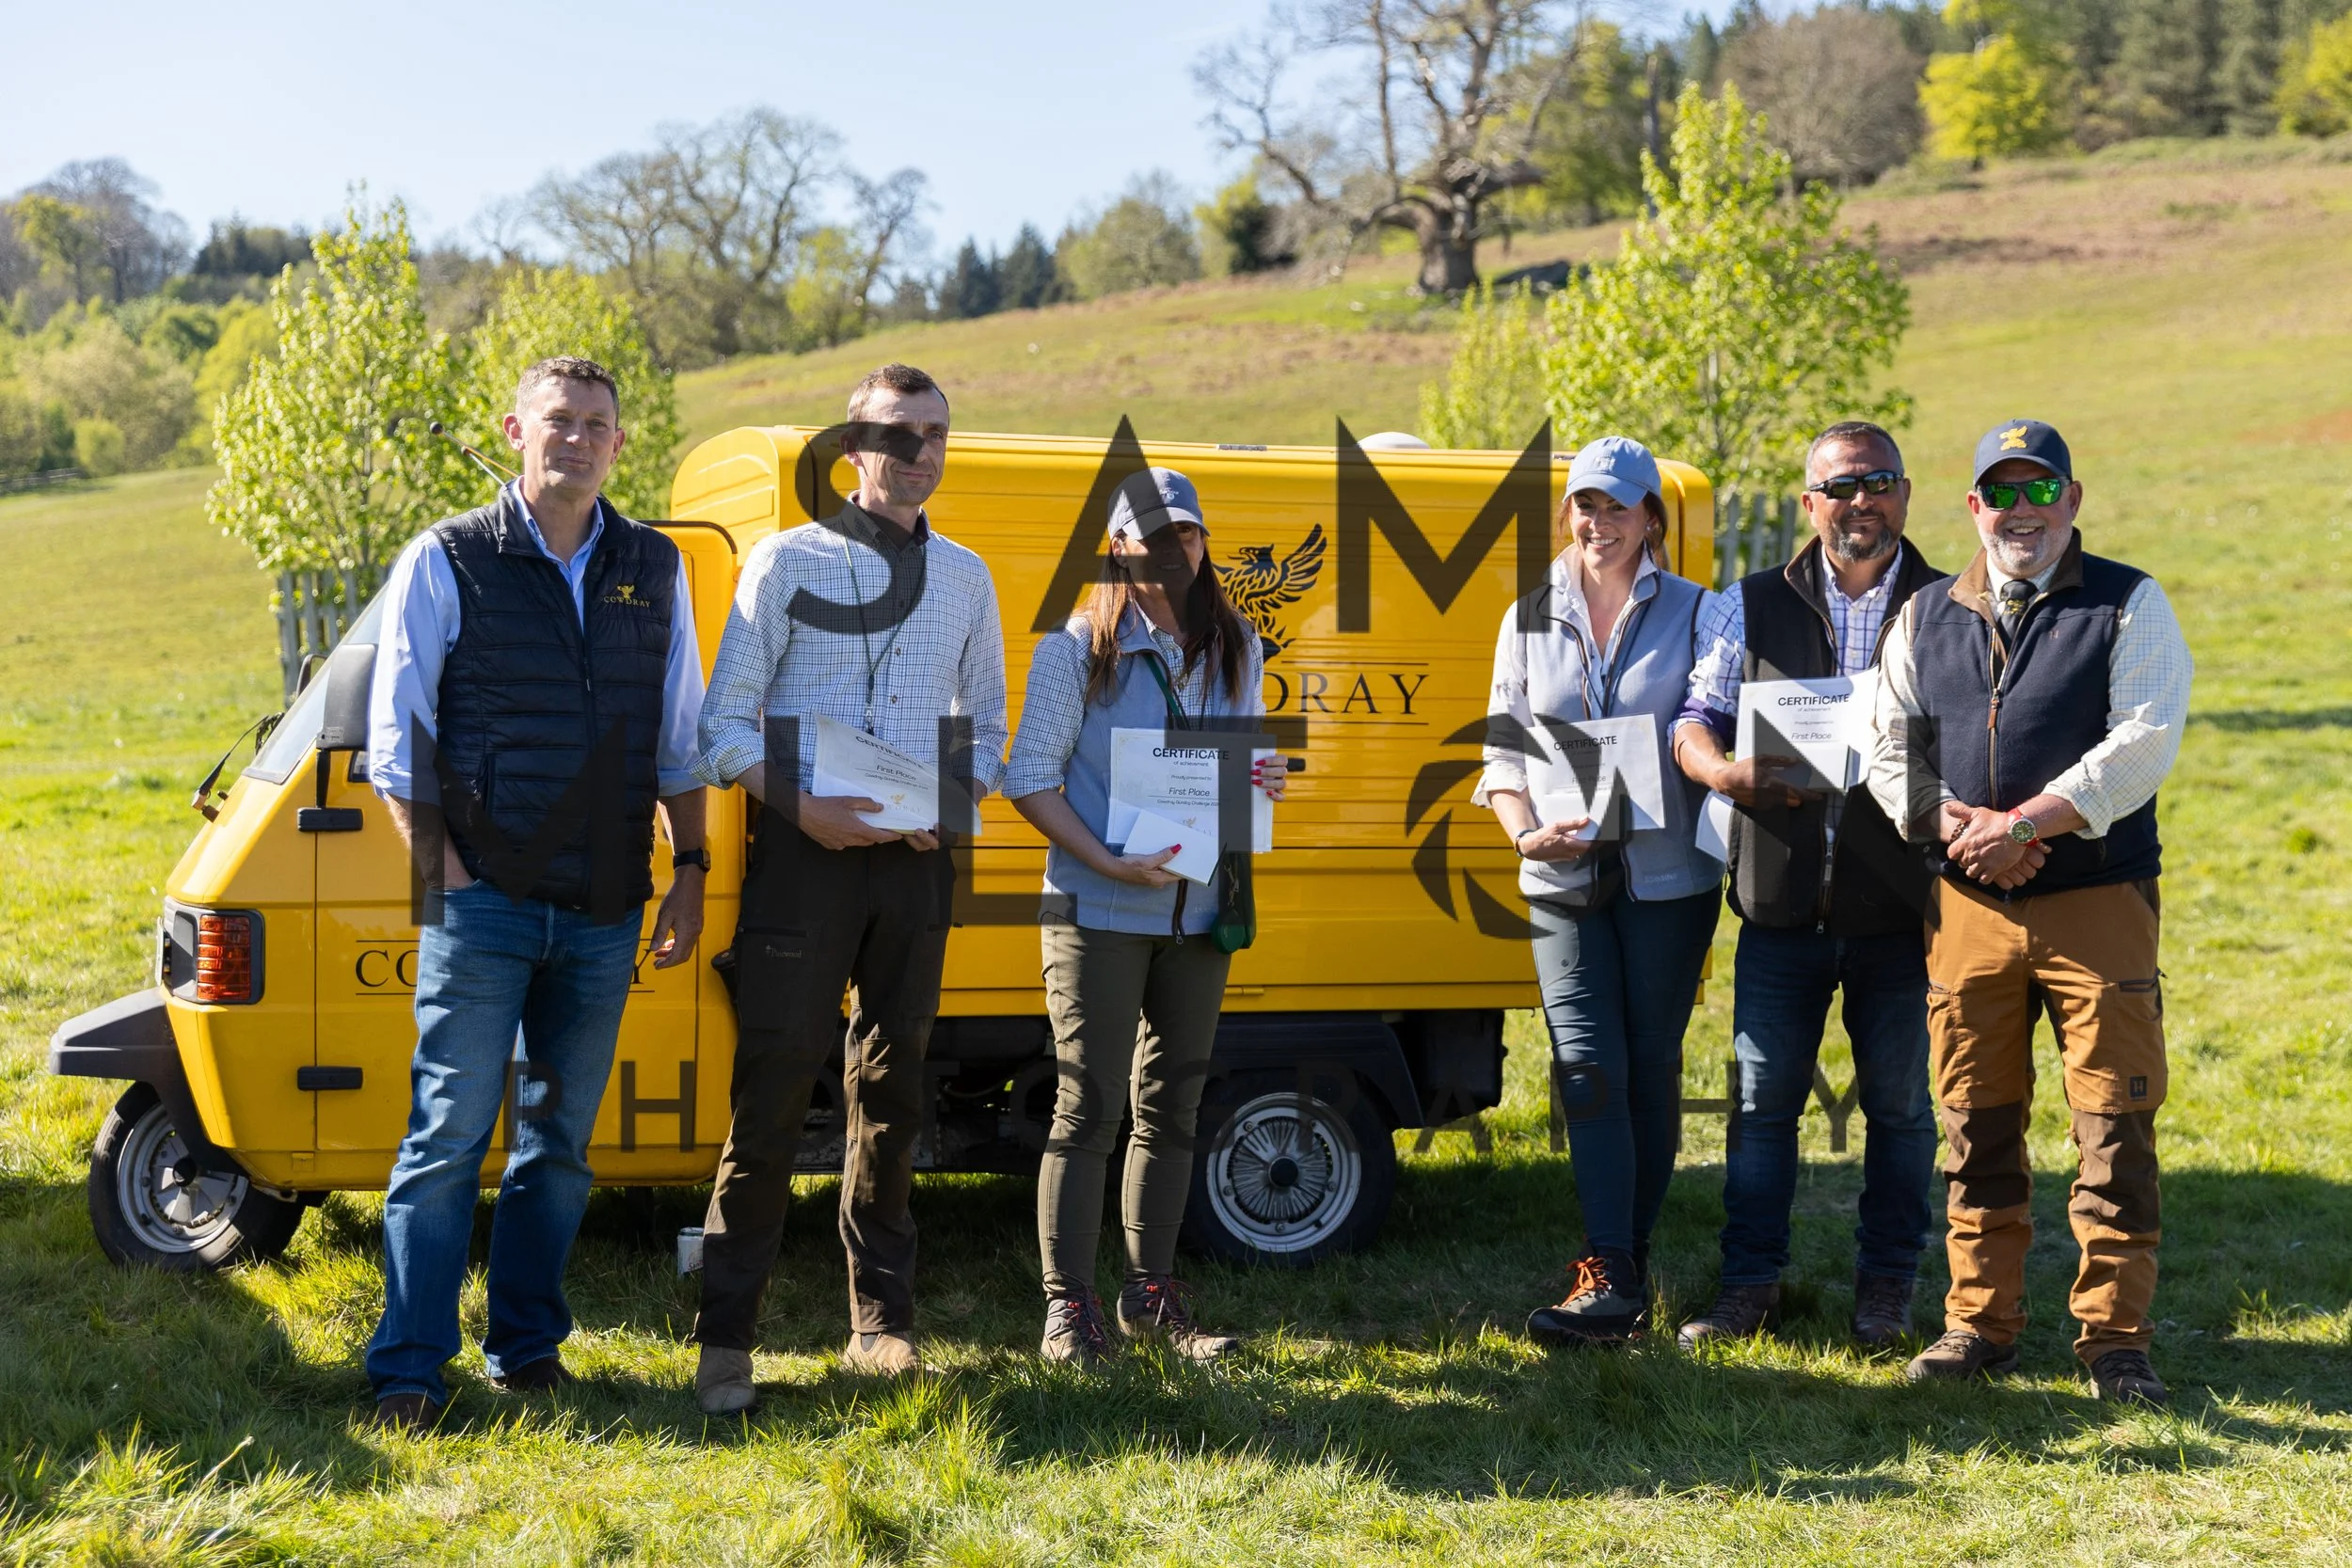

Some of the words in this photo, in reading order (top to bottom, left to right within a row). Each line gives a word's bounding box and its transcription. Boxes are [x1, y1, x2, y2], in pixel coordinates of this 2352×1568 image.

[603, 595, 651, 609] COWDRAY
[1263, 672, 1429, 715] DRAY
[1777, 693, 1851, 706] CERTIFICATE
[1791, 732, 1808, 740] First
[1809, 732, 1833, 740] Place
[1553, 736, 1618, 752] CERTIFICATE
[1152, 747, 1231, 760] CERTIFICATE
[876, 764, 895, 775] First
[896, 769, 917, 781] Place
[1168, 786, 1187, 796] First
[1187, 787, 1211, 797] Place
